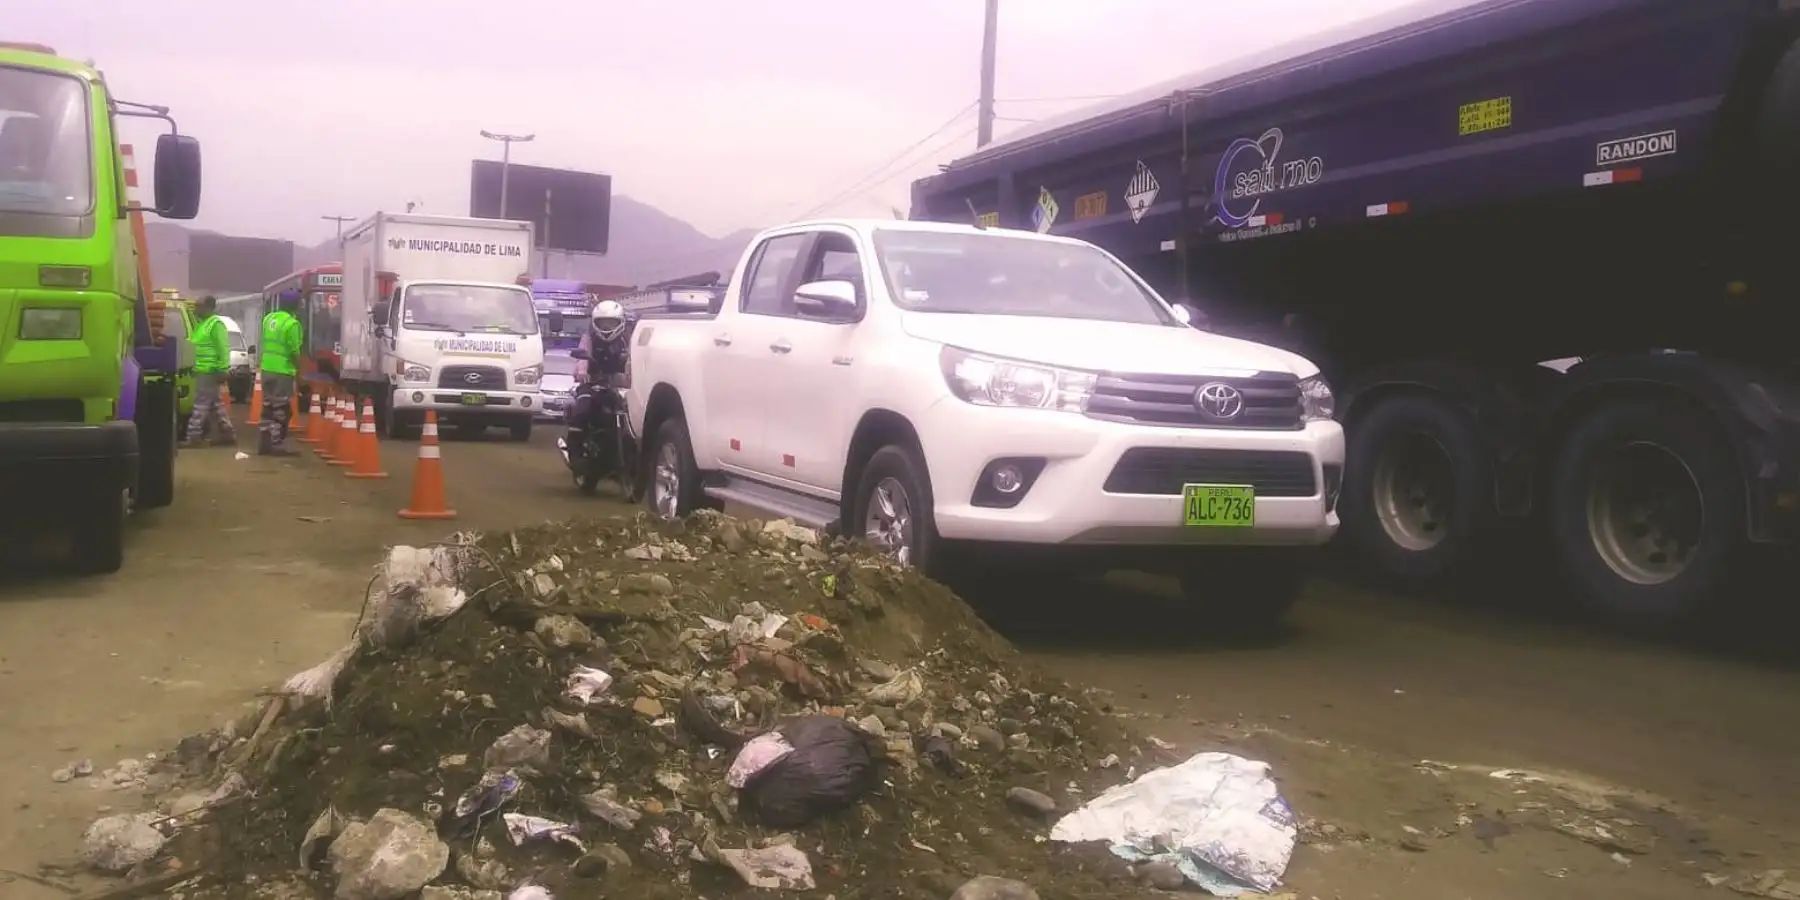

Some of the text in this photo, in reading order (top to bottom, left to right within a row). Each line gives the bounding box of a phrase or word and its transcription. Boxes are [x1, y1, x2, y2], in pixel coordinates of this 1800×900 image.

[1600, 134, 1674, 160] RANDON
[408, 239, 520, 257] MUNICIPALIDAD DE LIMA
[449, 339, 515, 353] MUNICIPALIDAD DE LIMA
[1188, 497, 1251, 520] ALC-736
